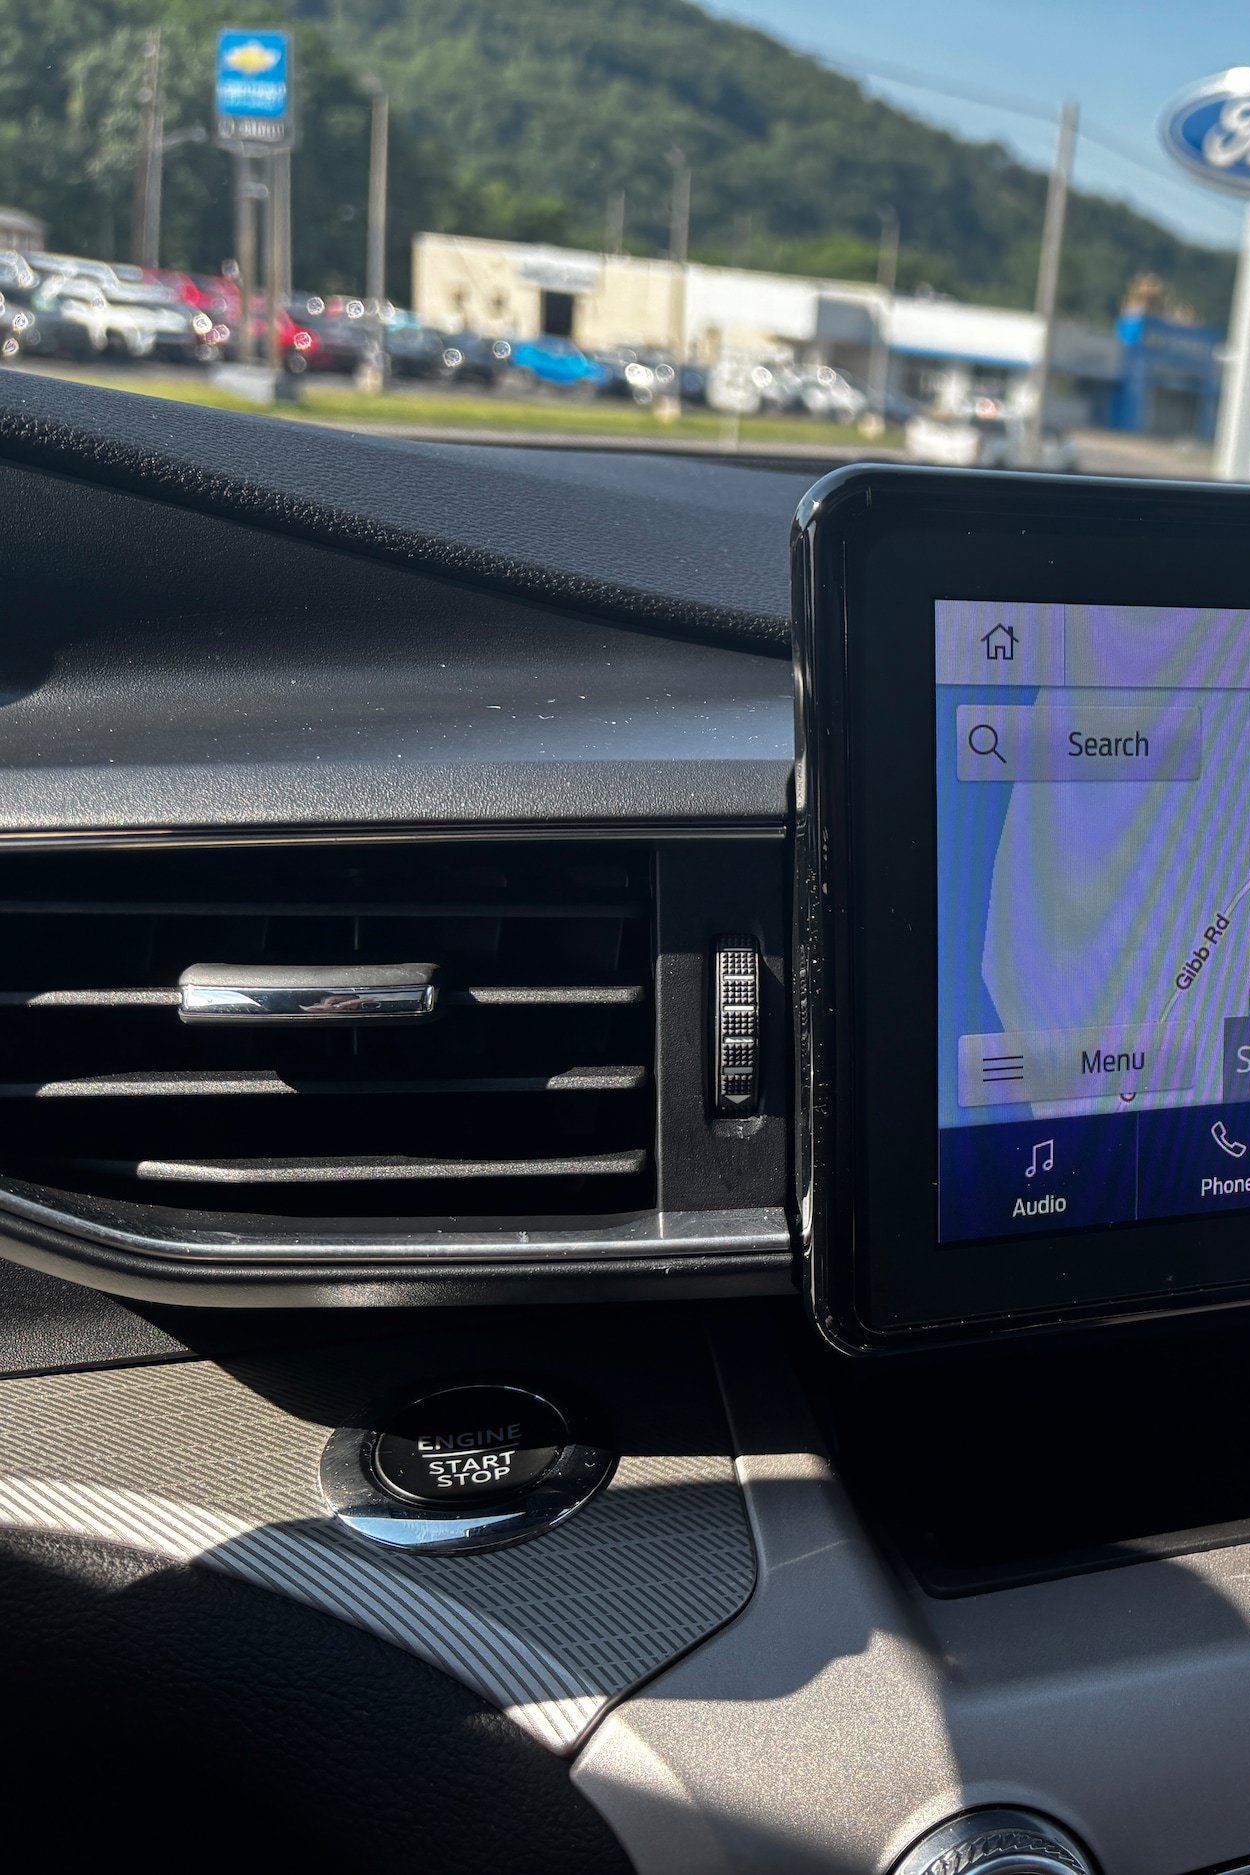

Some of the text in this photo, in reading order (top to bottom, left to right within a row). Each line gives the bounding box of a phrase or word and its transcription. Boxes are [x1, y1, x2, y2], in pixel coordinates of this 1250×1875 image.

[1068, 730, 1149, 757] Search
[1175, 912, 1231, 991] Gibb Rd
[1081, 1050, 1146, 1075] Menu
[1011, 1194, 1067, 1218] Audio
[417, 1423, 522, 1451] ENGINE
[429, 1450, 516, 1475] START
[437, 1466, 511, 1488] STOP
